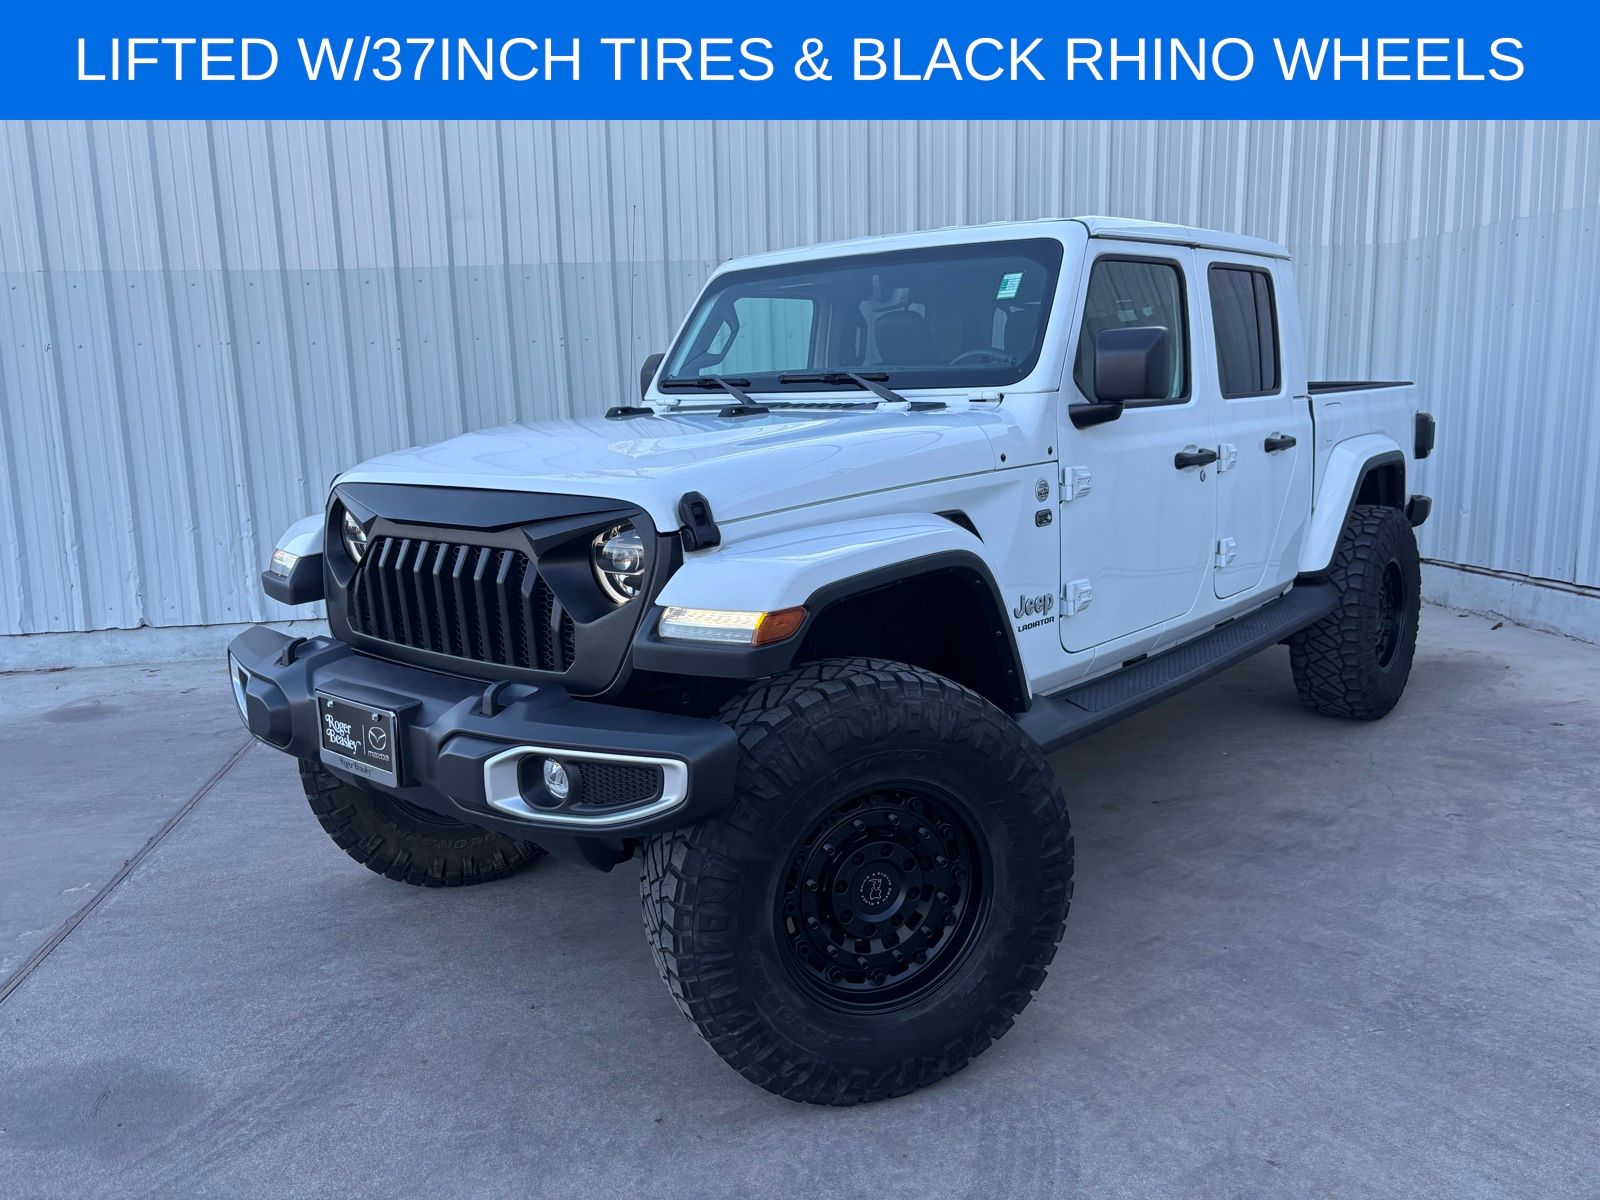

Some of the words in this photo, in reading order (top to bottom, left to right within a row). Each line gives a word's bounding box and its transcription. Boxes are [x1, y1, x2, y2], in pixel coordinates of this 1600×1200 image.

[1013, 593, 1054, 619] Jeep
[325, 714, 352, 736] Roger
[326, 728, 361, 755] Beasley
